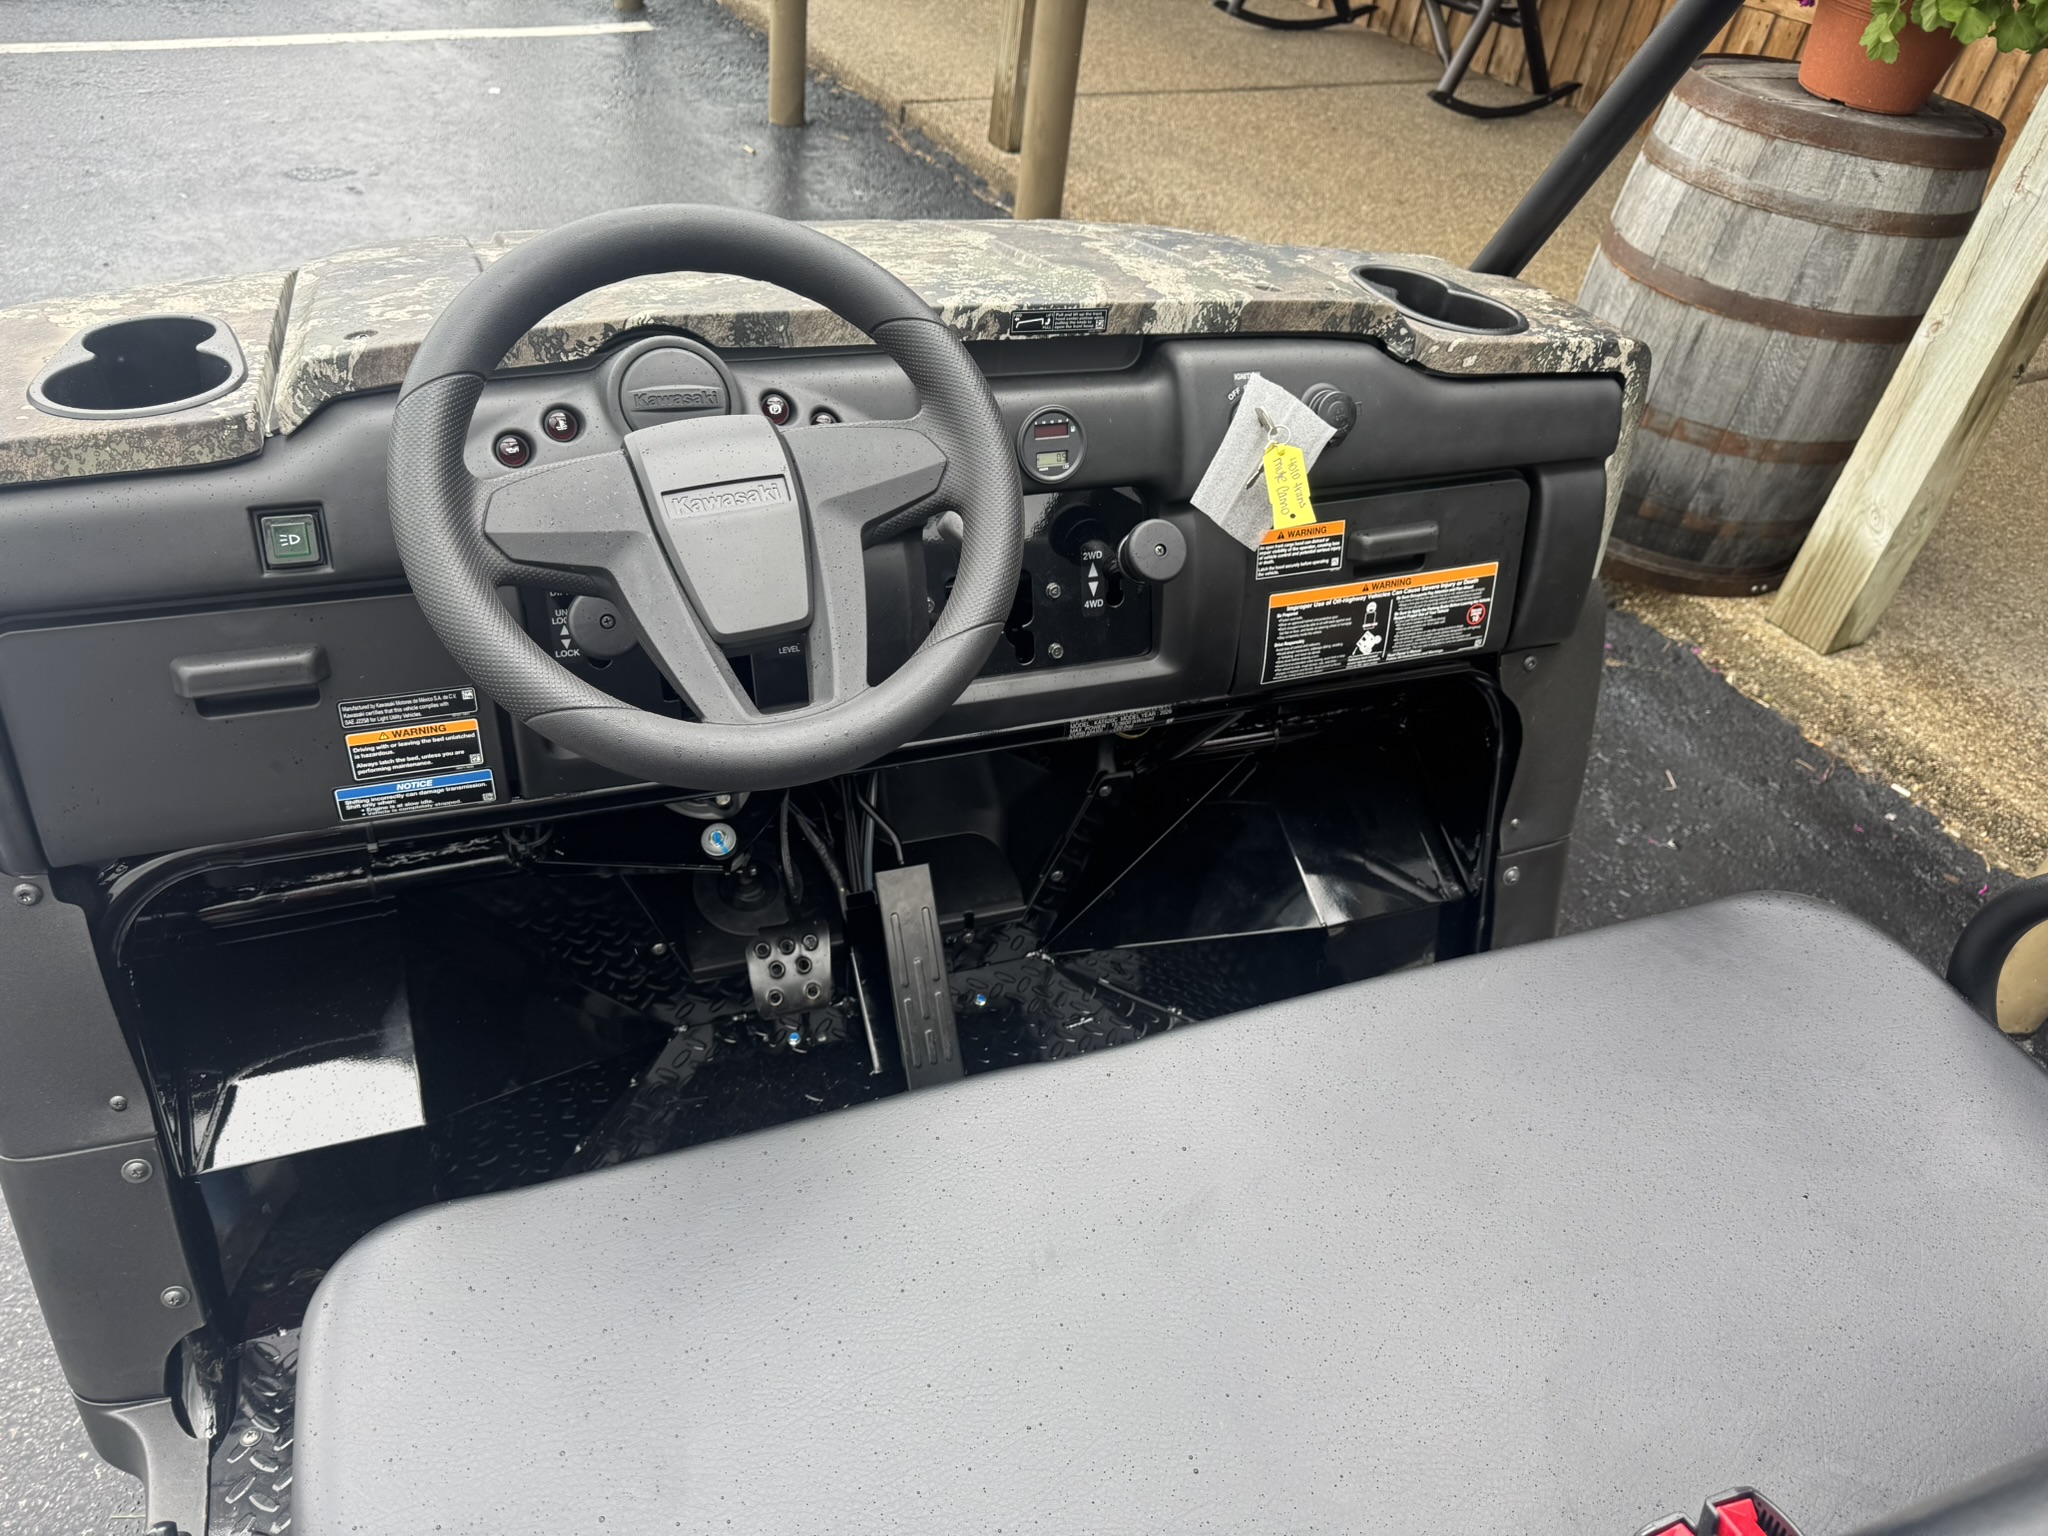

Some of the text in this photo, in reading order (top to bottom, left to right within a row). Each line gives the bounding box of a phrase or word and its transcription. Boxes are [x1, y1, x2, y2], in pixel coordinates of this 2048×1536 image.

[633, 390, 719, 408] Kawasaki
[1228, 386, 1240, 400] OFF
[671, 483, 782, 515] Kawasaki
[1288, 526, 1327, 538] WARNING
[1082, 550, 1103, 560] 2WD
[1372, 578, 1412, 590] WARNING
[1084, 598, 1104, 608] 4WD
[555, 649, 580, 658] LOCK
[778, 645, 800, 654] LEVEL
[392, 724, 446, 738] WARNING
[445, 732, 475, 740] unlatched
[361, 750, 395, 758] hazardous.
[357, 760, 433, 775] performing maintenance.
[396, 779, 433, 791] NOTICE
[370, 793, 404, 802] incorrectly
